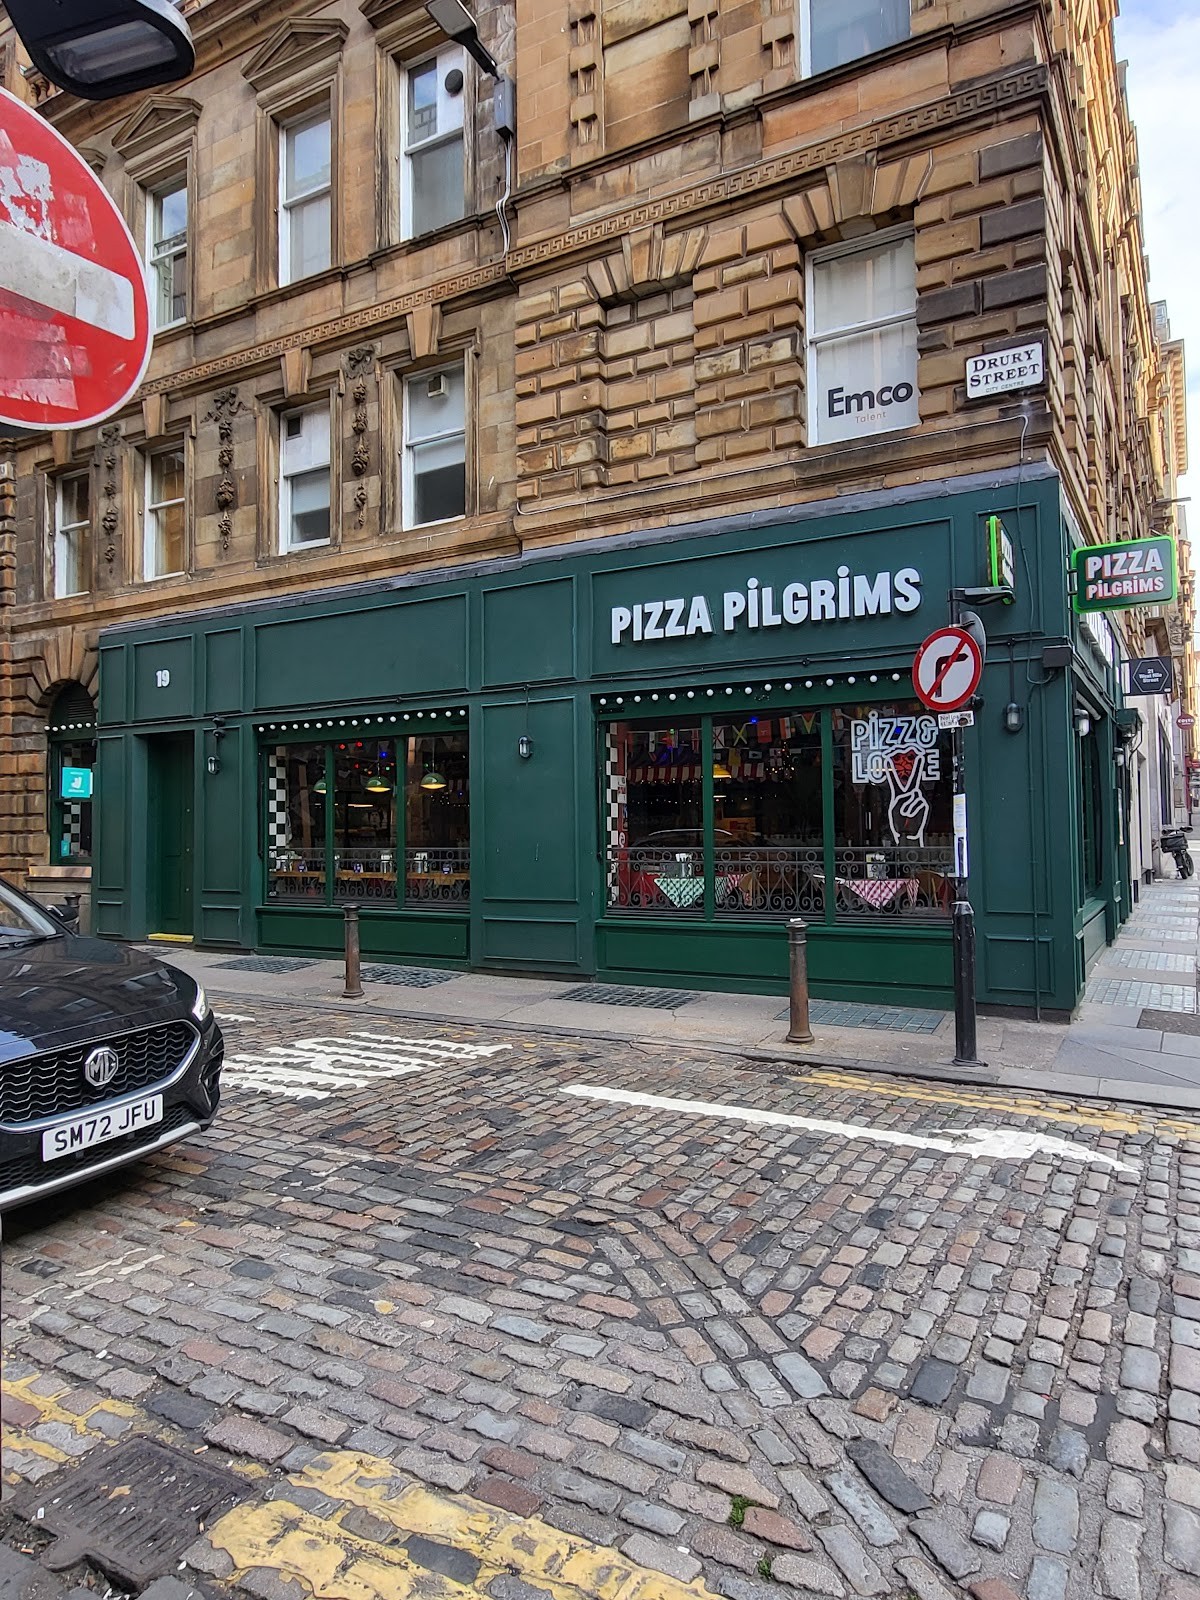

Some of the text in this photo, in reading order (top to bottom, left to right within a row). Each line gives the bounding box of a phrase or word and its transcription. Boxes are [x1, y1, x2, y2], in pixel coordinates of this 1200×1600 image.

[973, 349, 1035, 373] DRURY
[970, 363, 1040, 388] STREET
[1001, 380, 1024, 390] CENTRE
[828, 382, 913, 418] Emco
[855, 411, 887, 424] Talent
[1086, 548, 1164, 580] PIZZA
[611, 595, 713, 644] PIZZA
[155, 669, 170, 688] 19
[90, 1051, 117, 1082] MG
[55, 1100, 155, 1152] SM72 JFU
